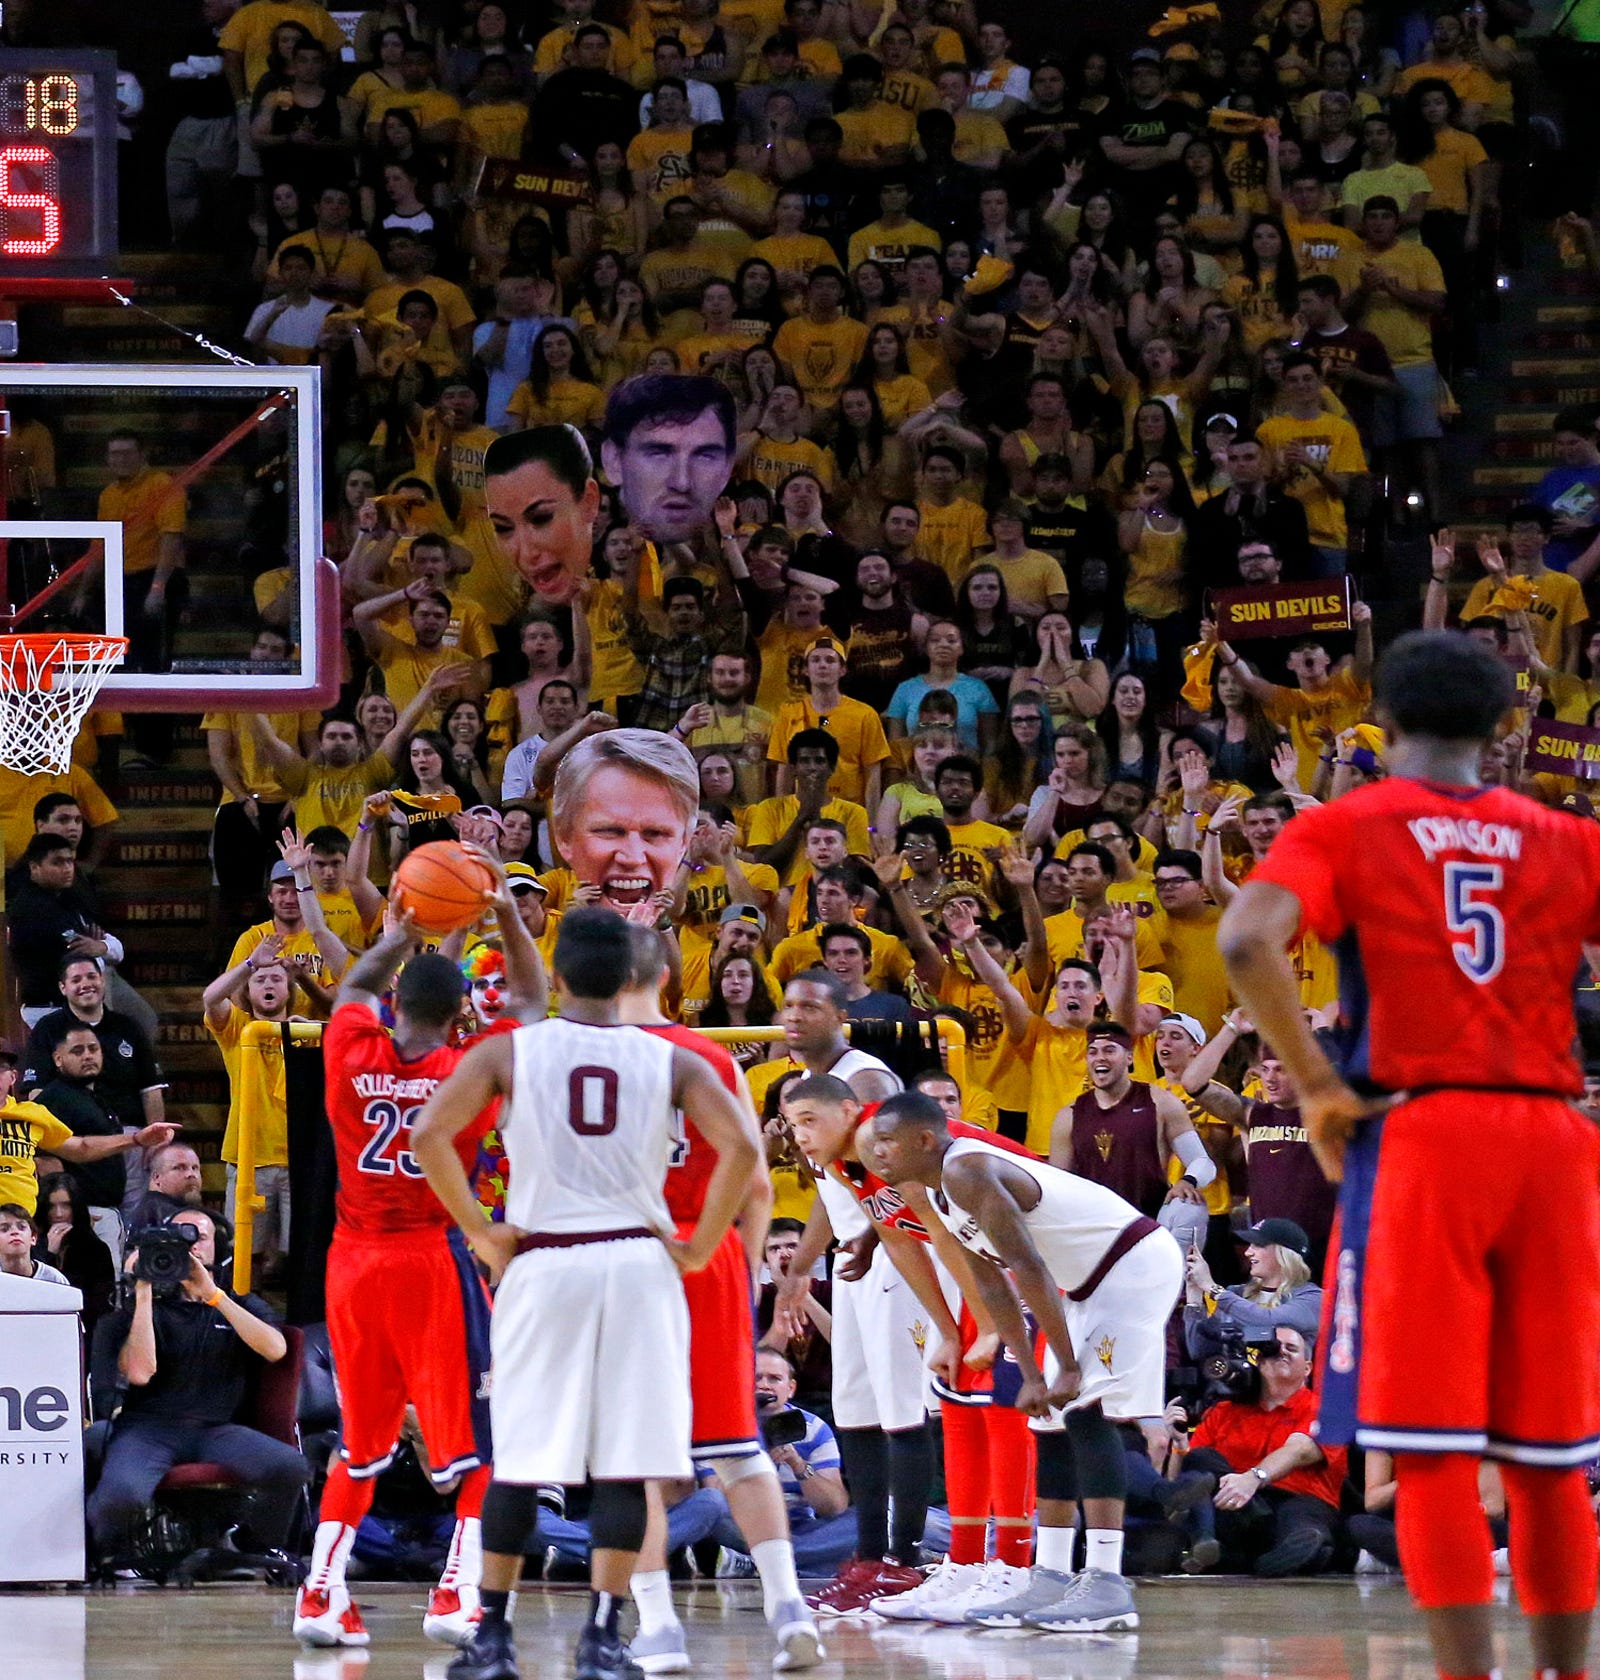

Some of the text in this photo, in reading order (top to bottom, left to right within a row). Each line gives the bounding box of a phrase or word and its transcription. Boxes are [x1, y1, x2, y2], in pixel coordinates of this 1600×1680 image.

[514, 173, 550, 193] SUN
[1230, 595, 1342, 623] SUN DEVILS
[1524, 601, 1558, 622] LUB
[1312, 620, 1347, 631] GEICO
[1536, 735, 1580, 760] SUN
[129, 784, 215, 801] INFERNO
[1407, 816, 1523, 863] JOHNSON
[1443, 860, 1505, 985] 5
[568, 1065, 619, 1136] 0
[1, 1140, 34, 1159] KITTY
